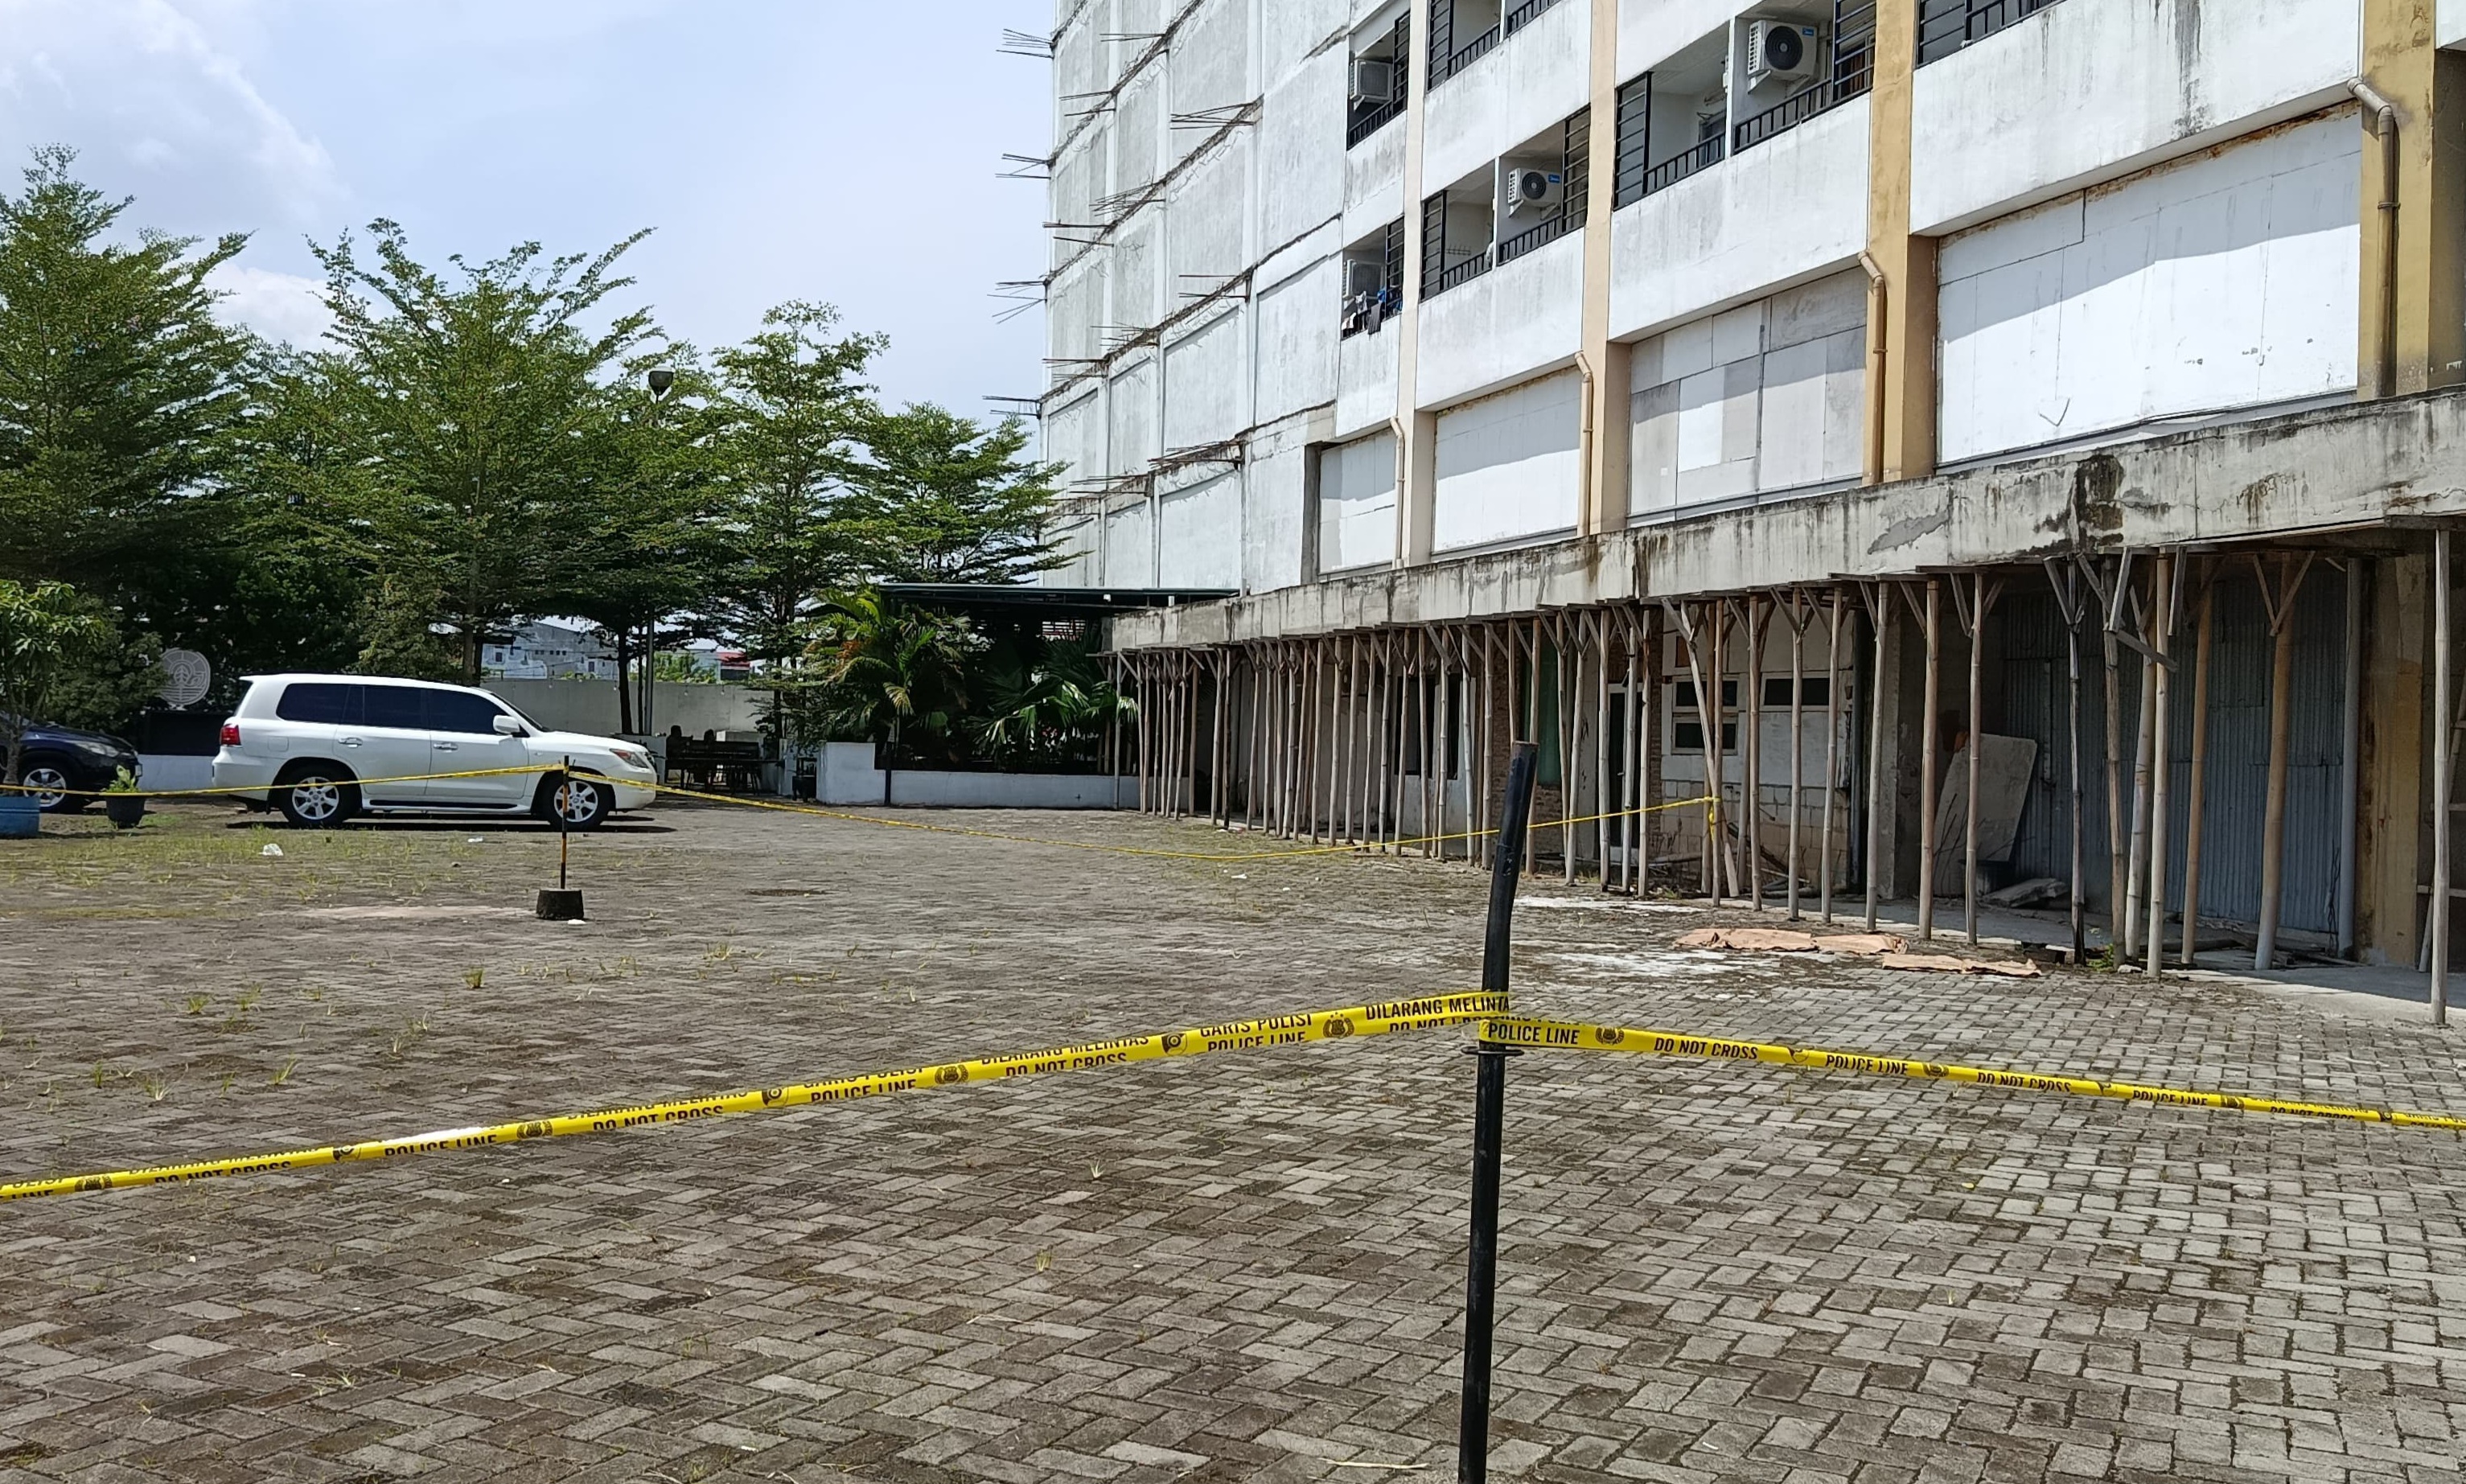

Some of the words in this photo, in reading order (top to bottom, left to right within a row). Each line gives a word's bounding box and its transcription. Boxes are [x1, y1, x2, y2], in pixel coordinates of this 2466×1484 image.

[1366, 999, 1443, 1020] DILARANG
[1200, 1022, 1251, 1038] GARIS
[1257, 1013, 1312, 1031] POLISI
[1488, 1022, 1542, 1042] POLICE
[1546, 1027, 1580, 1045] LINE
[1654, 1038, 1675, 1052] DO
[1679, 1039, 1708, 1054] NOT
[1711, 1042, 1759, 1059] CROSS
[1825, 1054, 1873, 1071] POLICE
[1878, 1060, 1909, 1075] LINE
